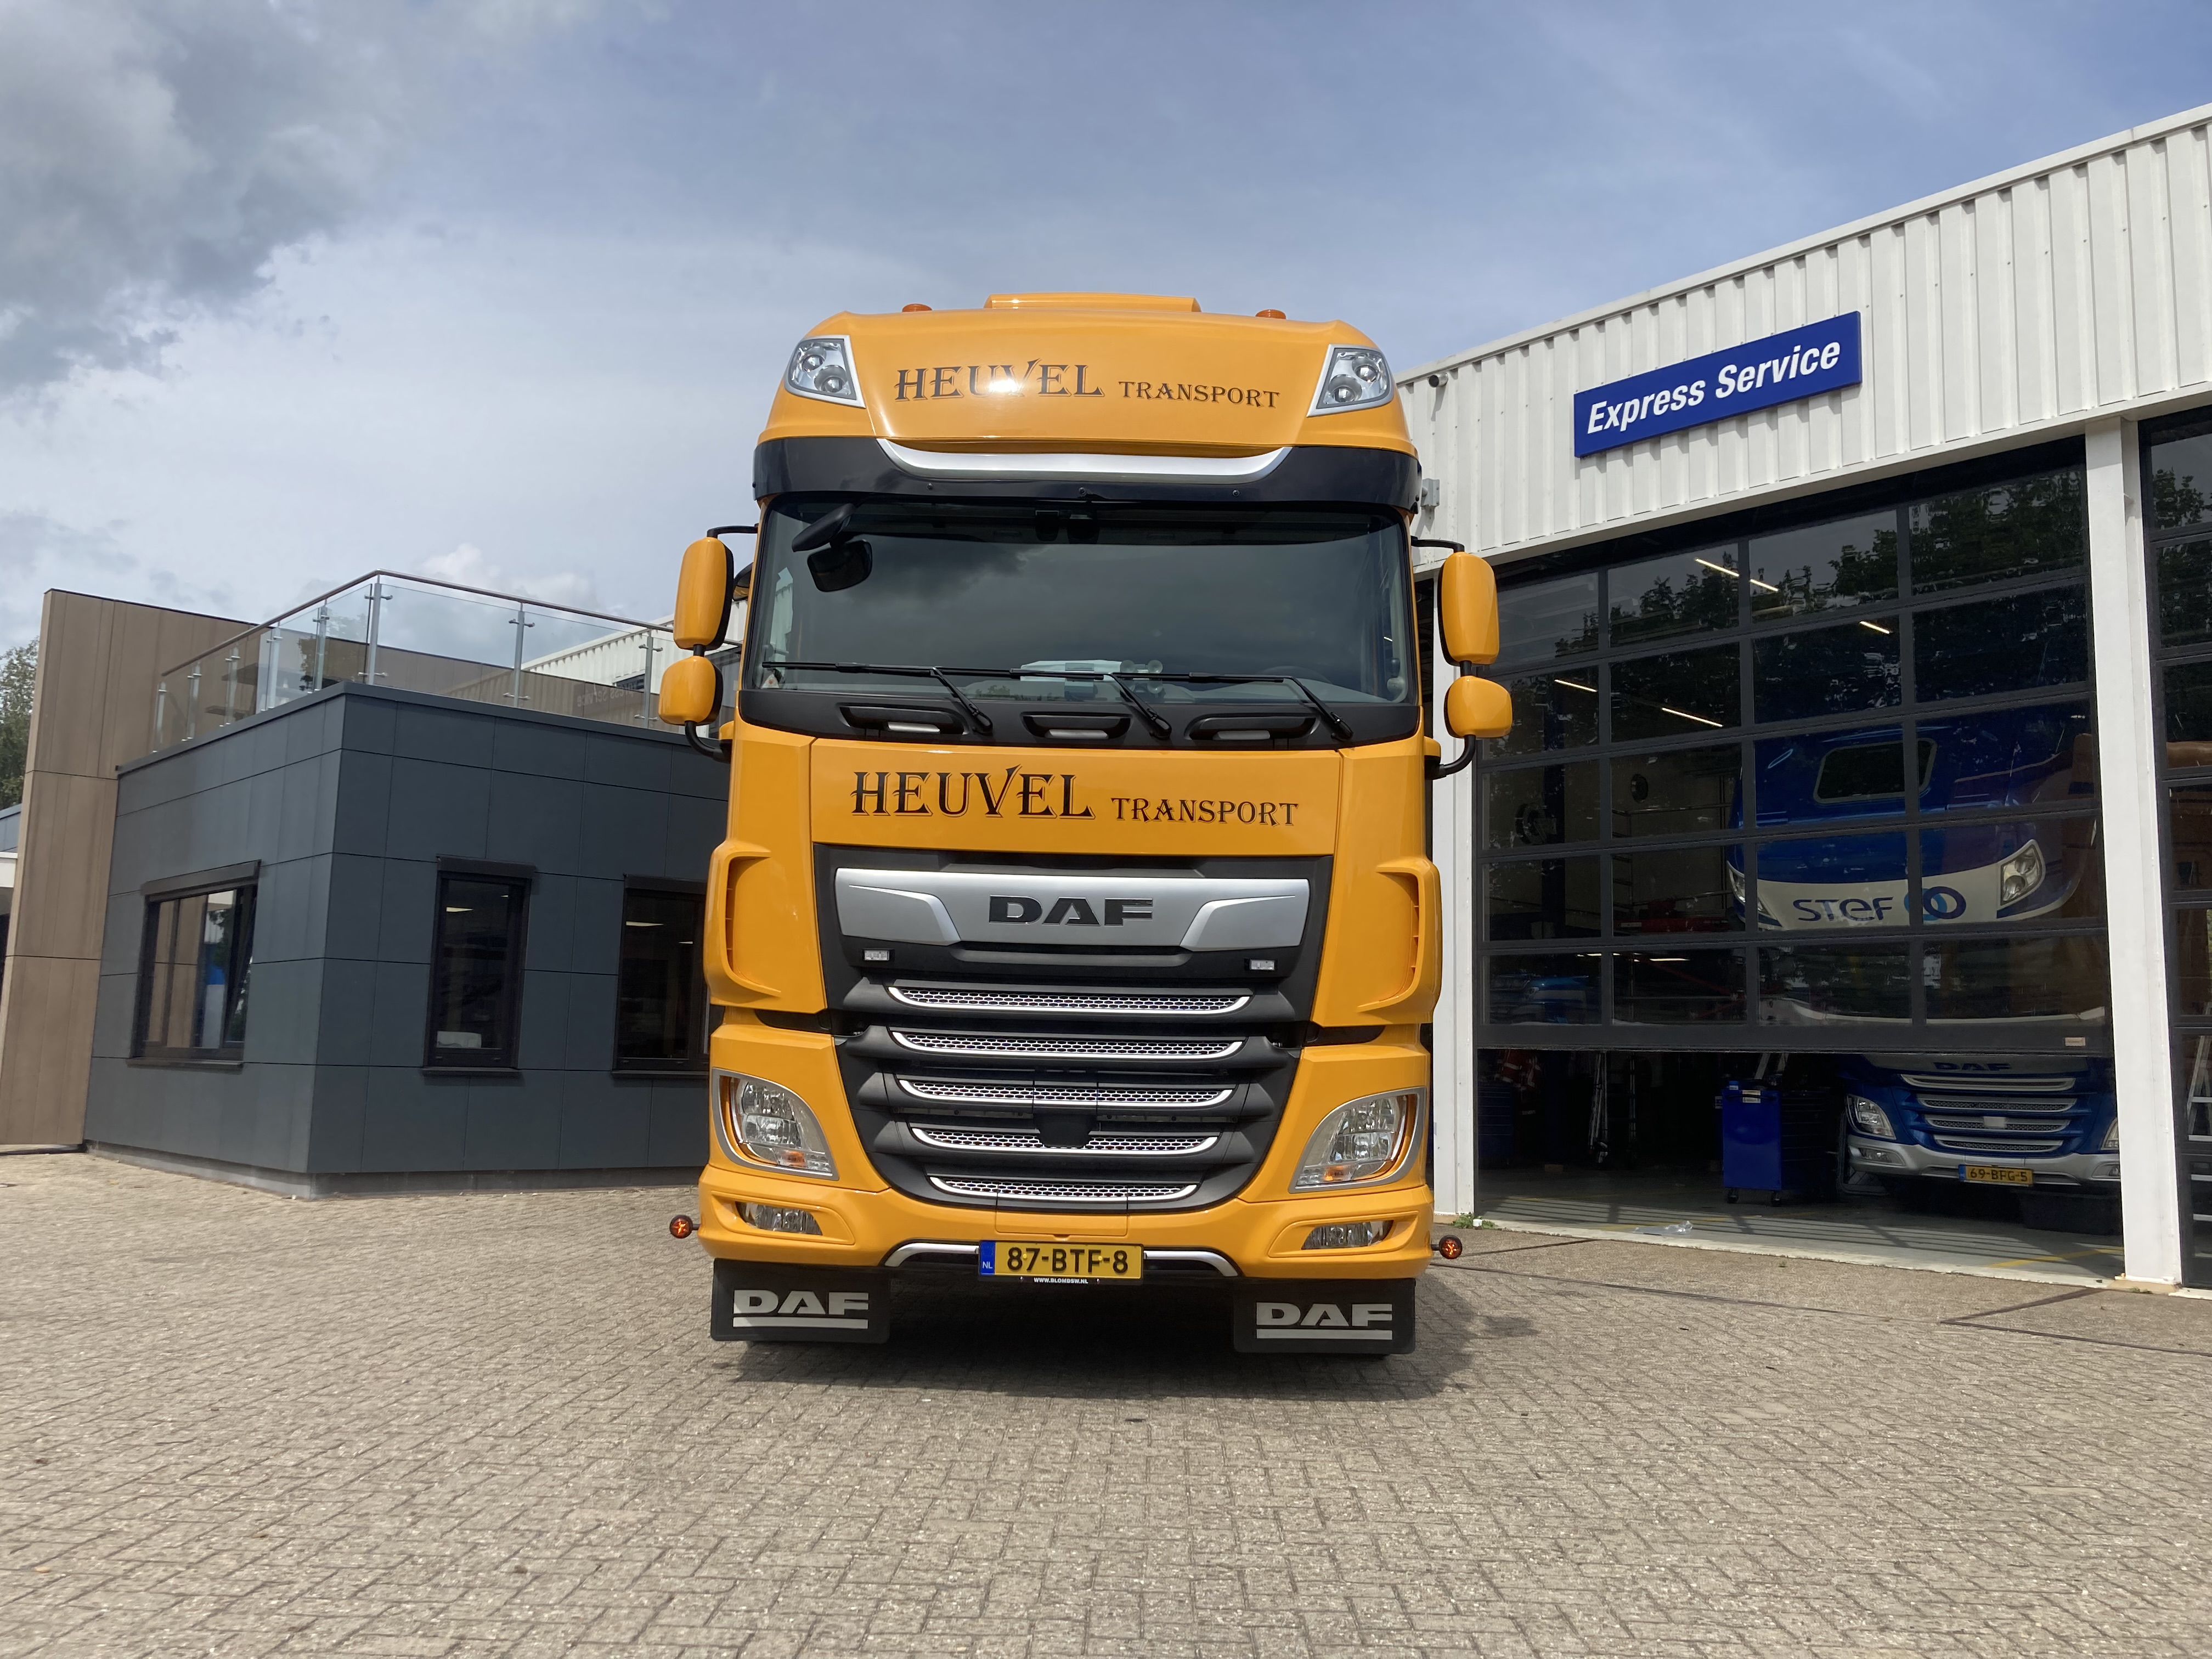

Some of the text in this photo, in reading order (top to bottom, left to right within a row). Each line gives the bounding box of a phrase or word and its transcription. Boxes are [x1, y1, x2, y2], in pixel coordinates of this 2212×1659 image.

[894, 358, 1280, 409] HEUVEL TRANSPORT
[1587, 341, 1841, 435] Express Service
[850, 764, 1299, 827] HEUVEL TRANSPORT
[989, 895, 1153, 927] DAF
[1933, 1062, 2012, 1071] DAF
[1970, 1168, 2028, 1182] 69-BFG-5
[982, 1261, 994, 1269] NL
[1007, 1246, 1128, 1273] 87-BTF-8
[733, 1290, 869, 1315] DAF
[1256, 1302, 1393, 1327] DAF
